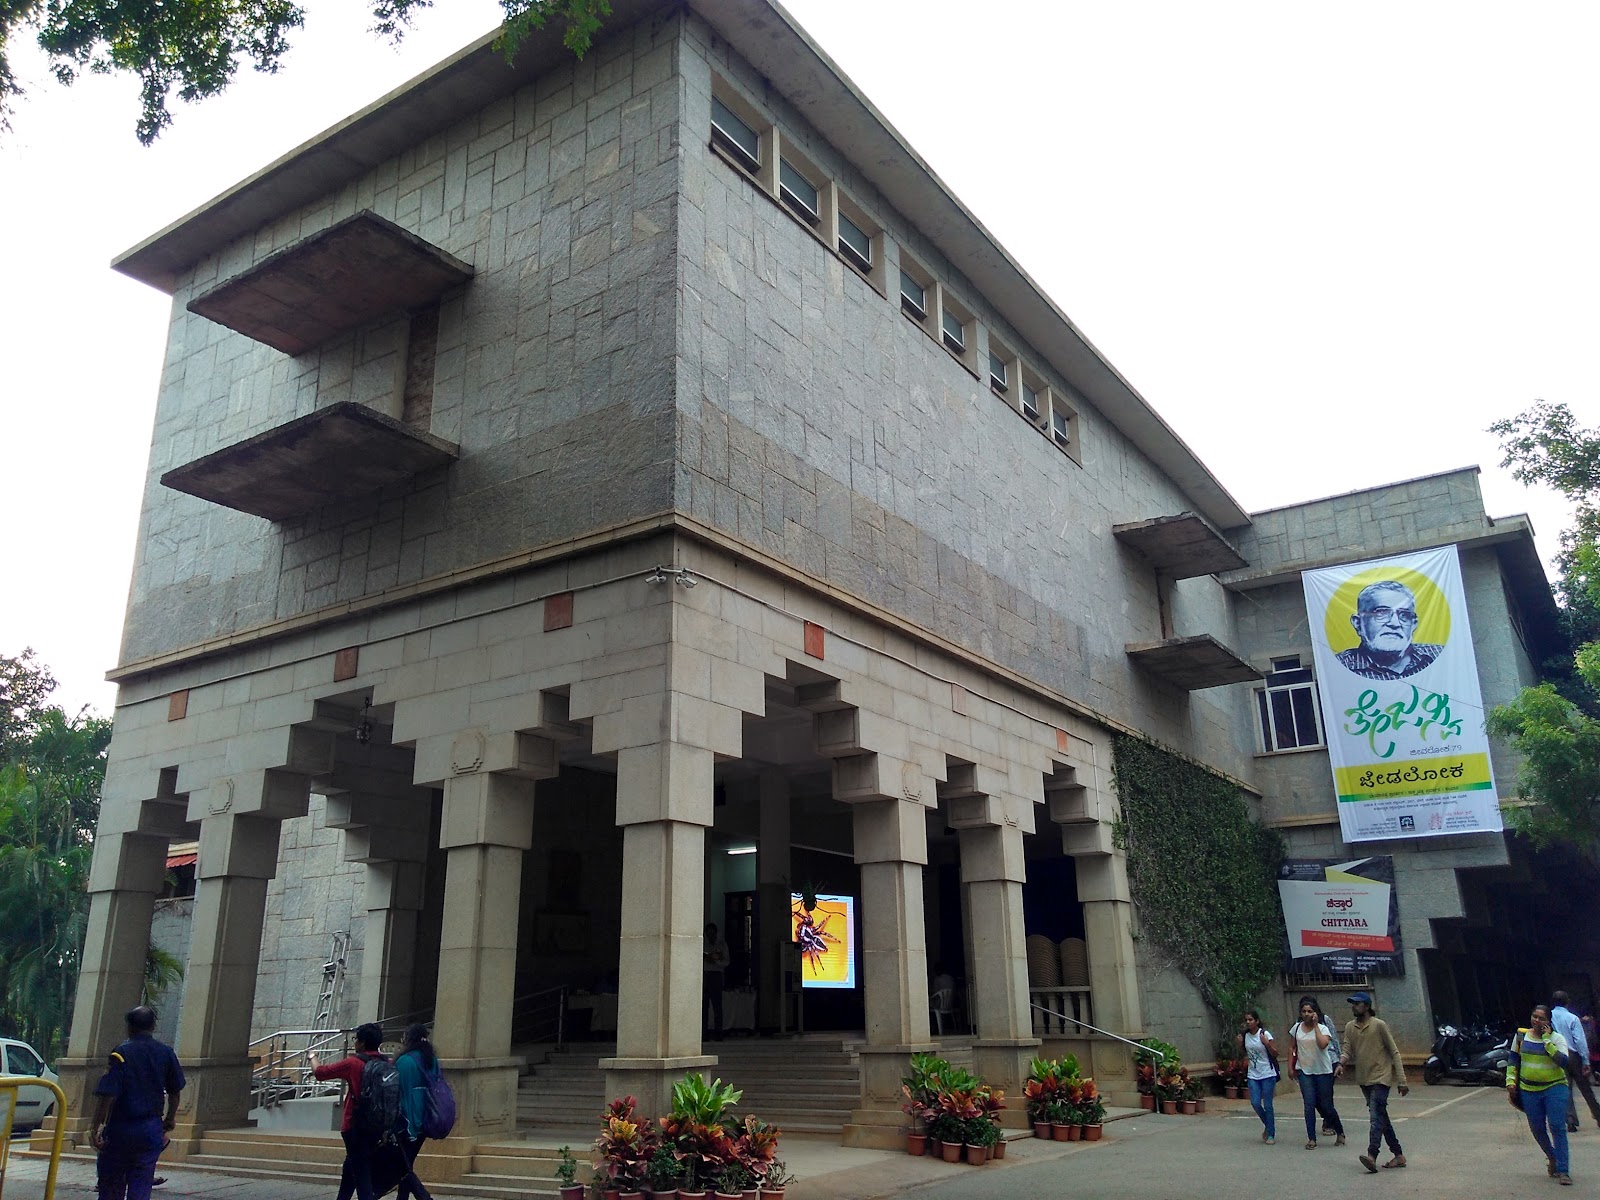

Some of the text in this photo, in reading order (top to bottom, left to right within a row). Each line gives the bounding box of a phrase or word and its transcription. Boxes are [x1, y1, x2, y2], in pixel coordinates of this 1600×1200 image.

[1344, 685, 1464, 758] ತೇಜಸ್ವಿ
[1360, 763, 1463, 787] ಜೇಡಲೋಕ
[1321, 918, 1368, 927] CHITTARA
